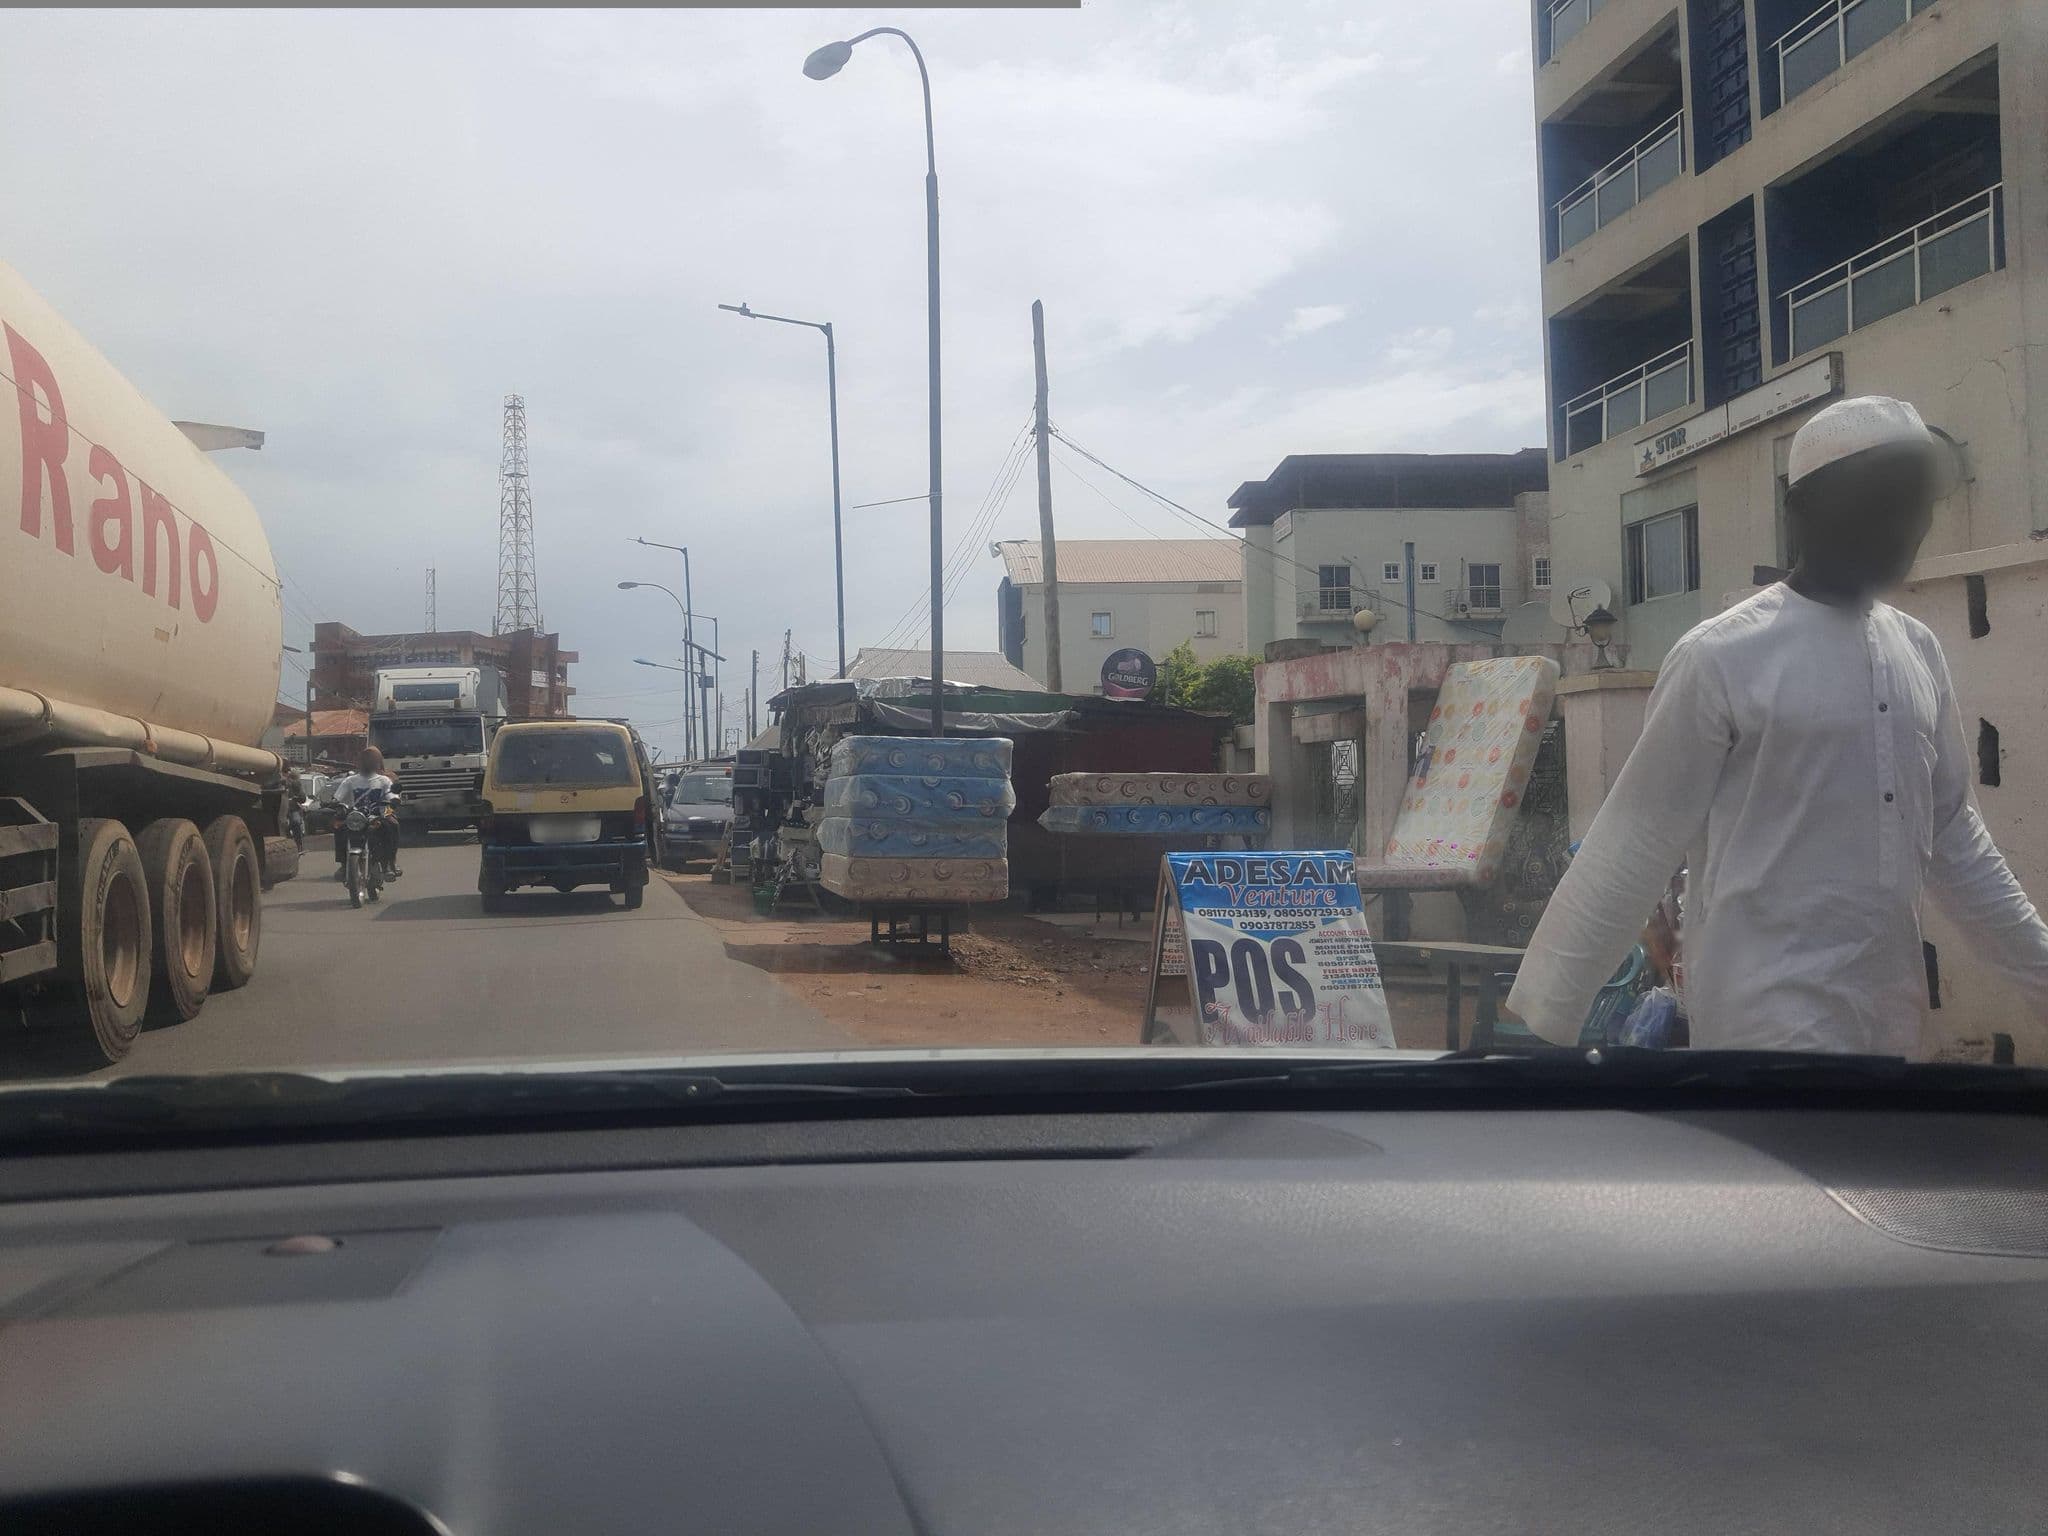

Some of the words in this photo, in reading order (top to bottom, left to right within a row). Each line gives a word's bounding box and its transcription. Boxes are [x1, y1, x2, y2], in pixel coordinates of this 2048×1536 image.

[1655, 427, 1687, 455] STAR
[2, 319, 219, 623] Rano
[1107, 672, 1149, 686] GOLDBERG
[1183, 860, 1356, 885] ADESAM
[1219, 882, 1337, 906] Venture
[1191, 937, 1316, 1024] POS
[1317, 995, 1378, 1041] Here
